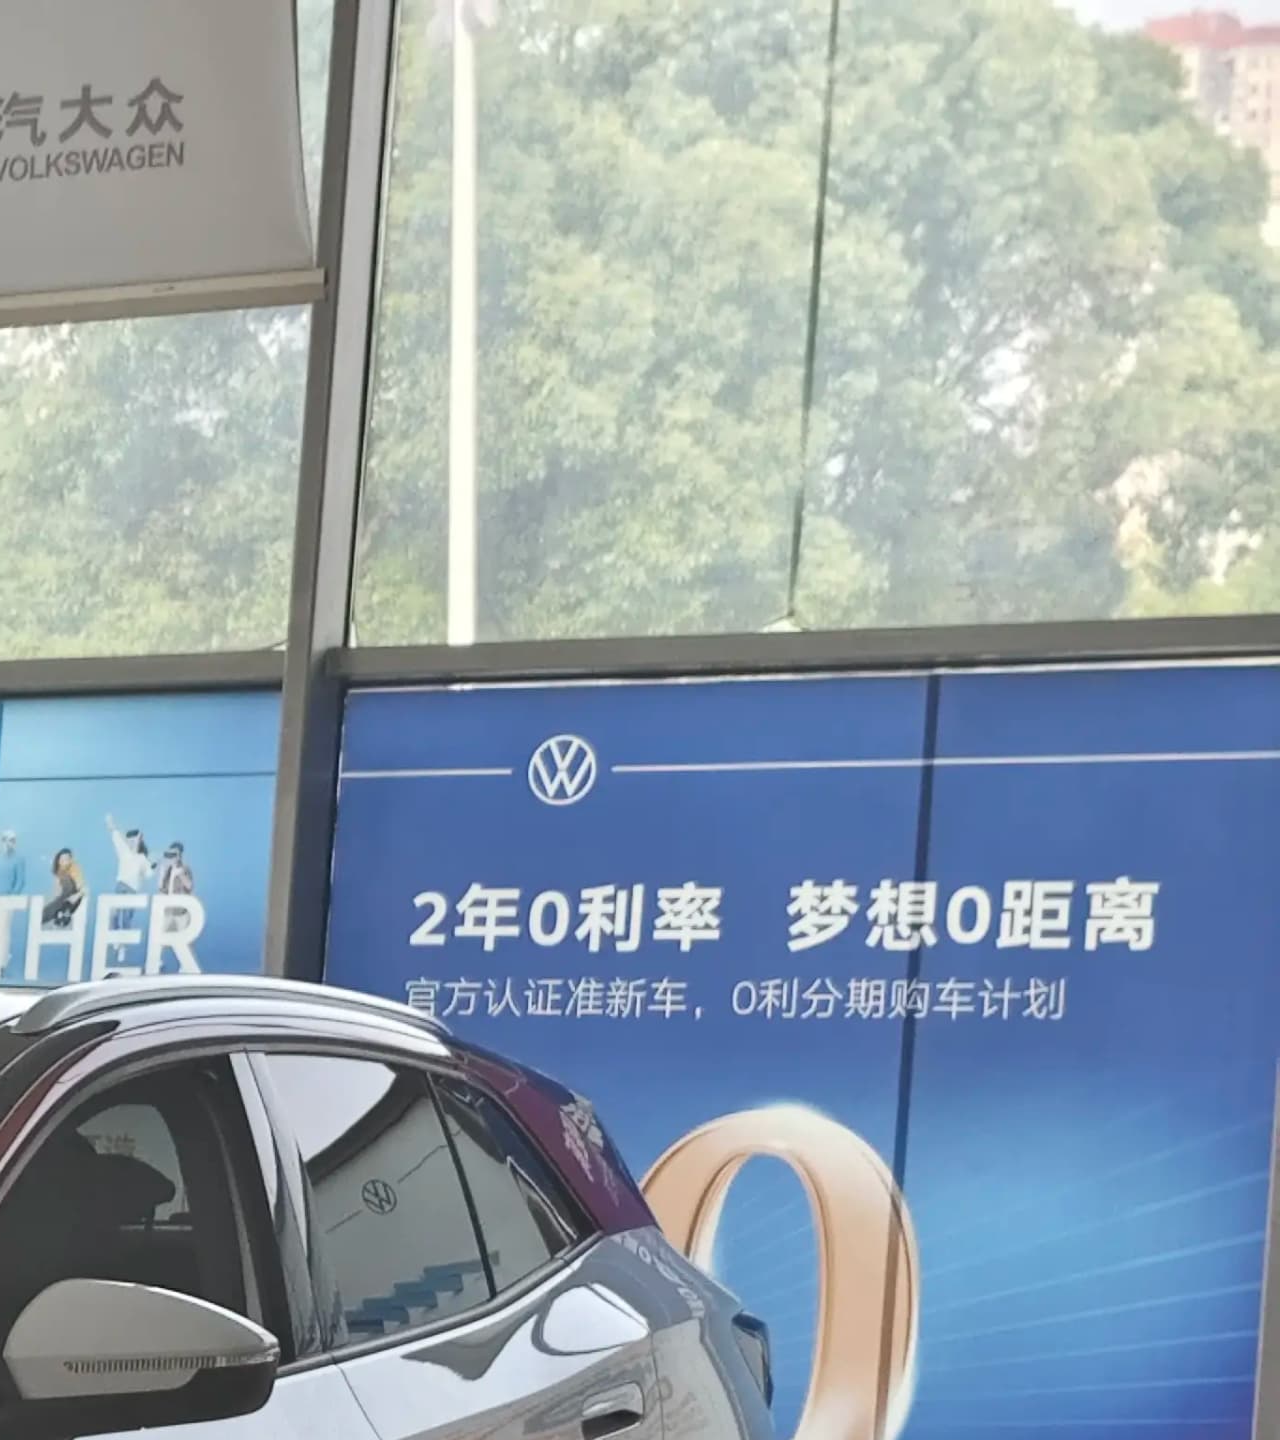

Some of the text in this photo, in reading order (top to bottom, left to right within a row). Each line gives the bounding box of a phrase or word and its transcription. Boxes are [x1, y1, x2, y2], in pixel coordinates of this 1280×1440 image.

[408, 877, 1160, 952] 2年0利率 梦想0距离
